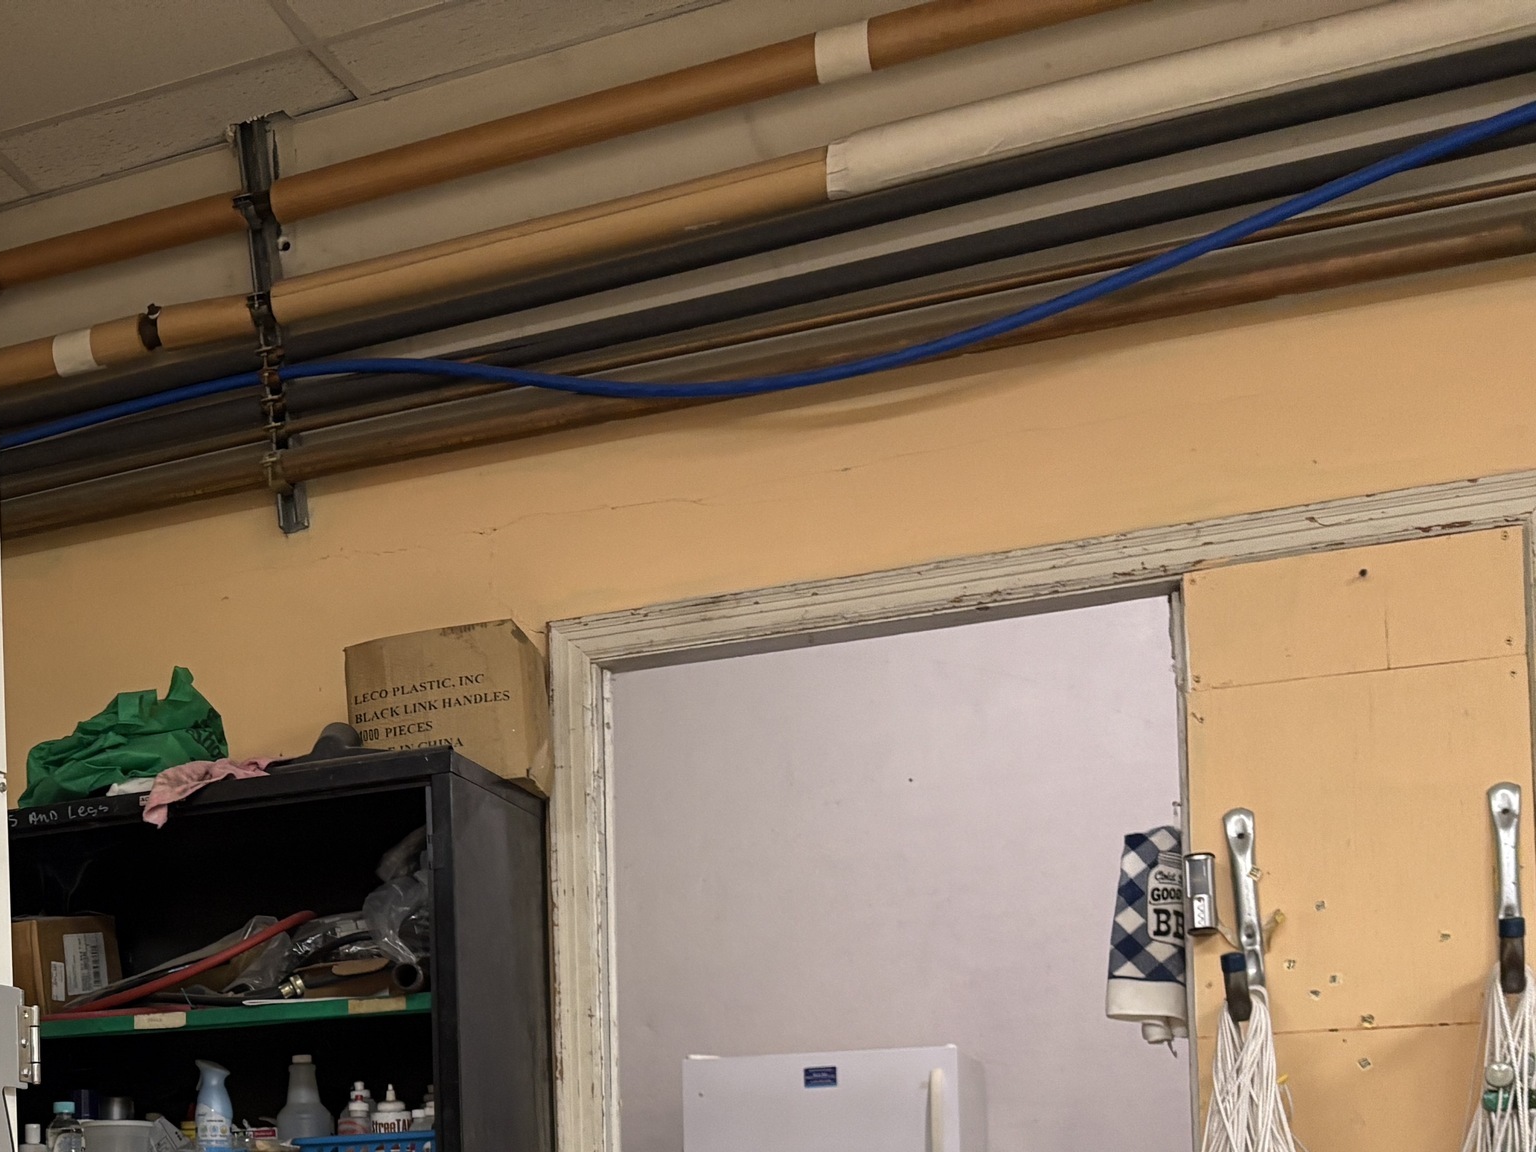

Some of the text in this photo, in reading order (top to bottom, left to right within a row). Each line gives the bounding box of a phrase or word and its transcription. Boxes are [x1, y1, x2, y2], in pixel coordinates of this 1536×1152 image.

[354, 688, 389, 705] LECO
[459, 673, 485, 687] INC
[355, 690, 511, 724] BLACK LINK HANDLES
[384, 720, 433, 738] PIECES
